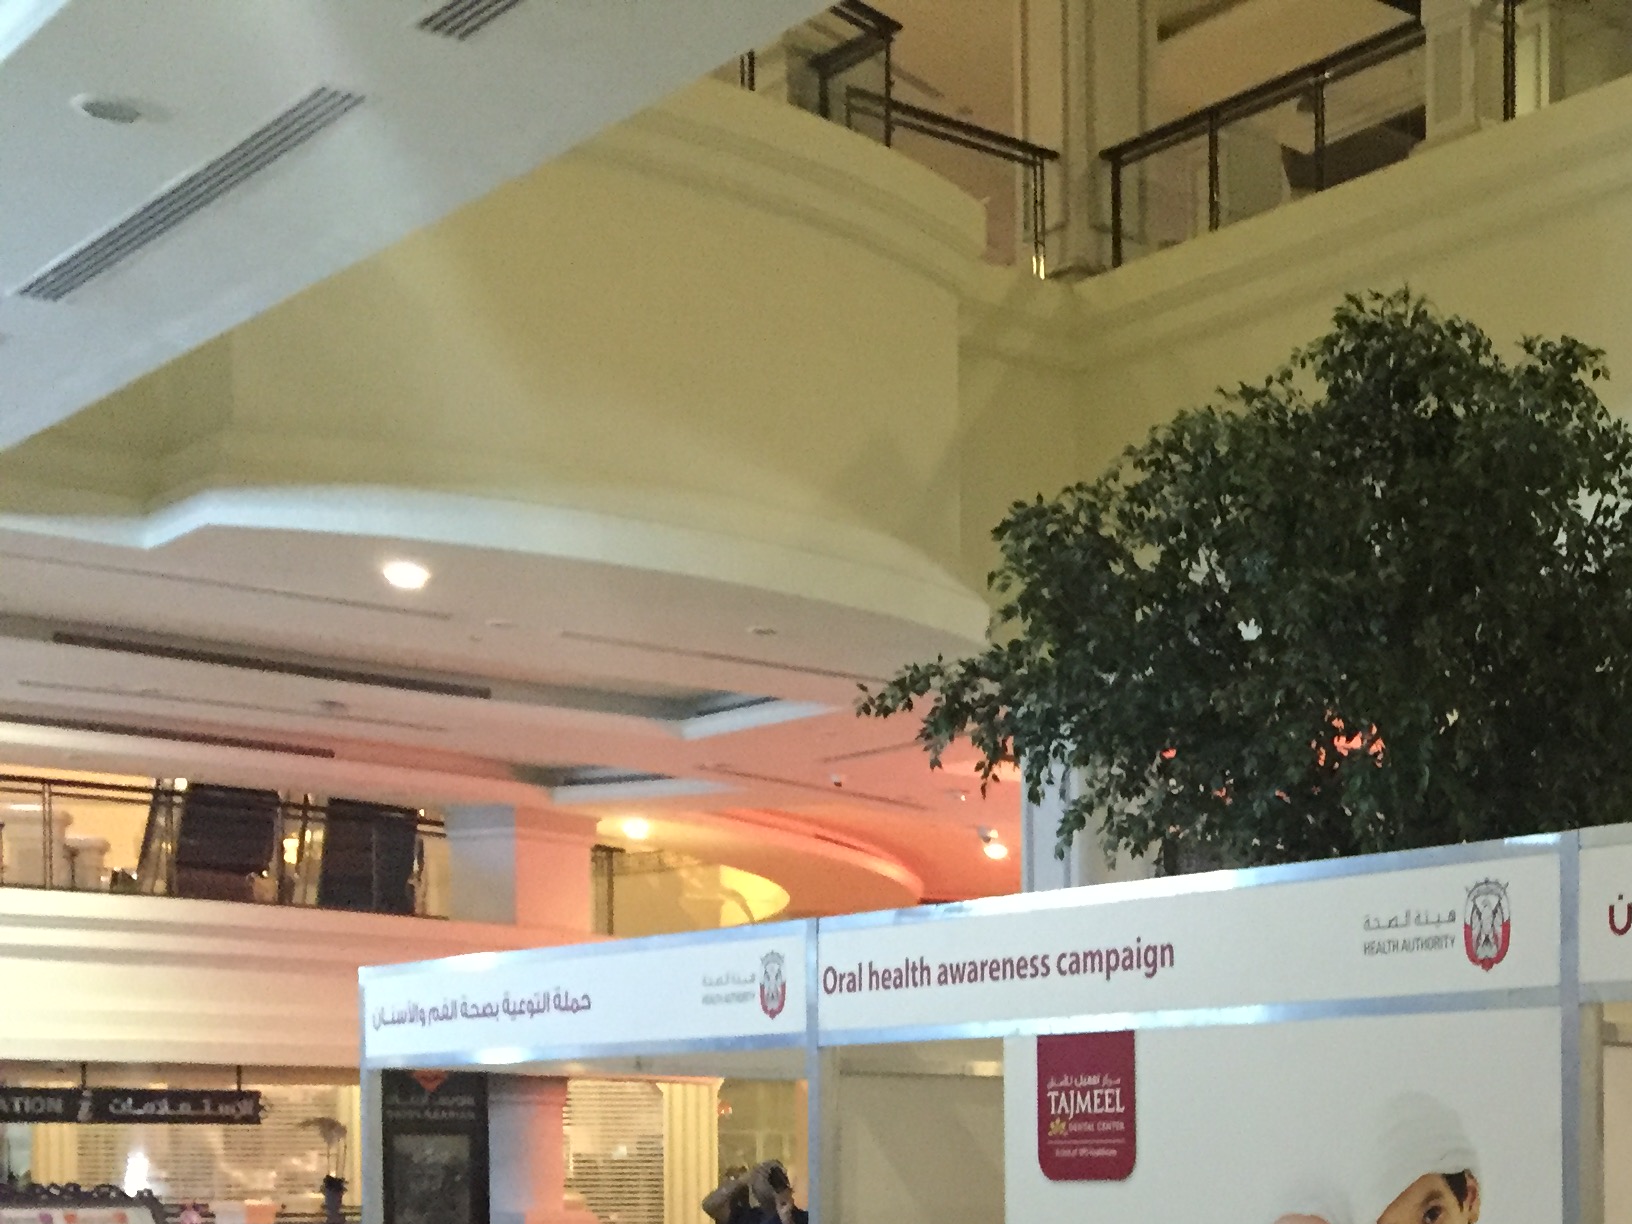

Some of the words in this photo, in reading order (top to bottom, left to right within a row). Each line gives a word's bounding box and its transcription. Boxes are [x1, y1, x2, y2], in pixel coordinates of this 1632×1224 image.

[1363, 938, 1399, 956] HEALTH
[1401, 935, 1456, 952] AUTHORITY
[822, 961, 864, 996] Oral
[868, 955, 932, 991] health
[937, 951, 1051, 987] awareness
[1056, 936, 1176, 982] campaign
[459, 994, 500, 1021] بصحة
[501, 991, 551, 1021] التوعية
[553, 986, 592, 1014] حملة
[1047, 1087, 1126, 1120] TAJMEEL
